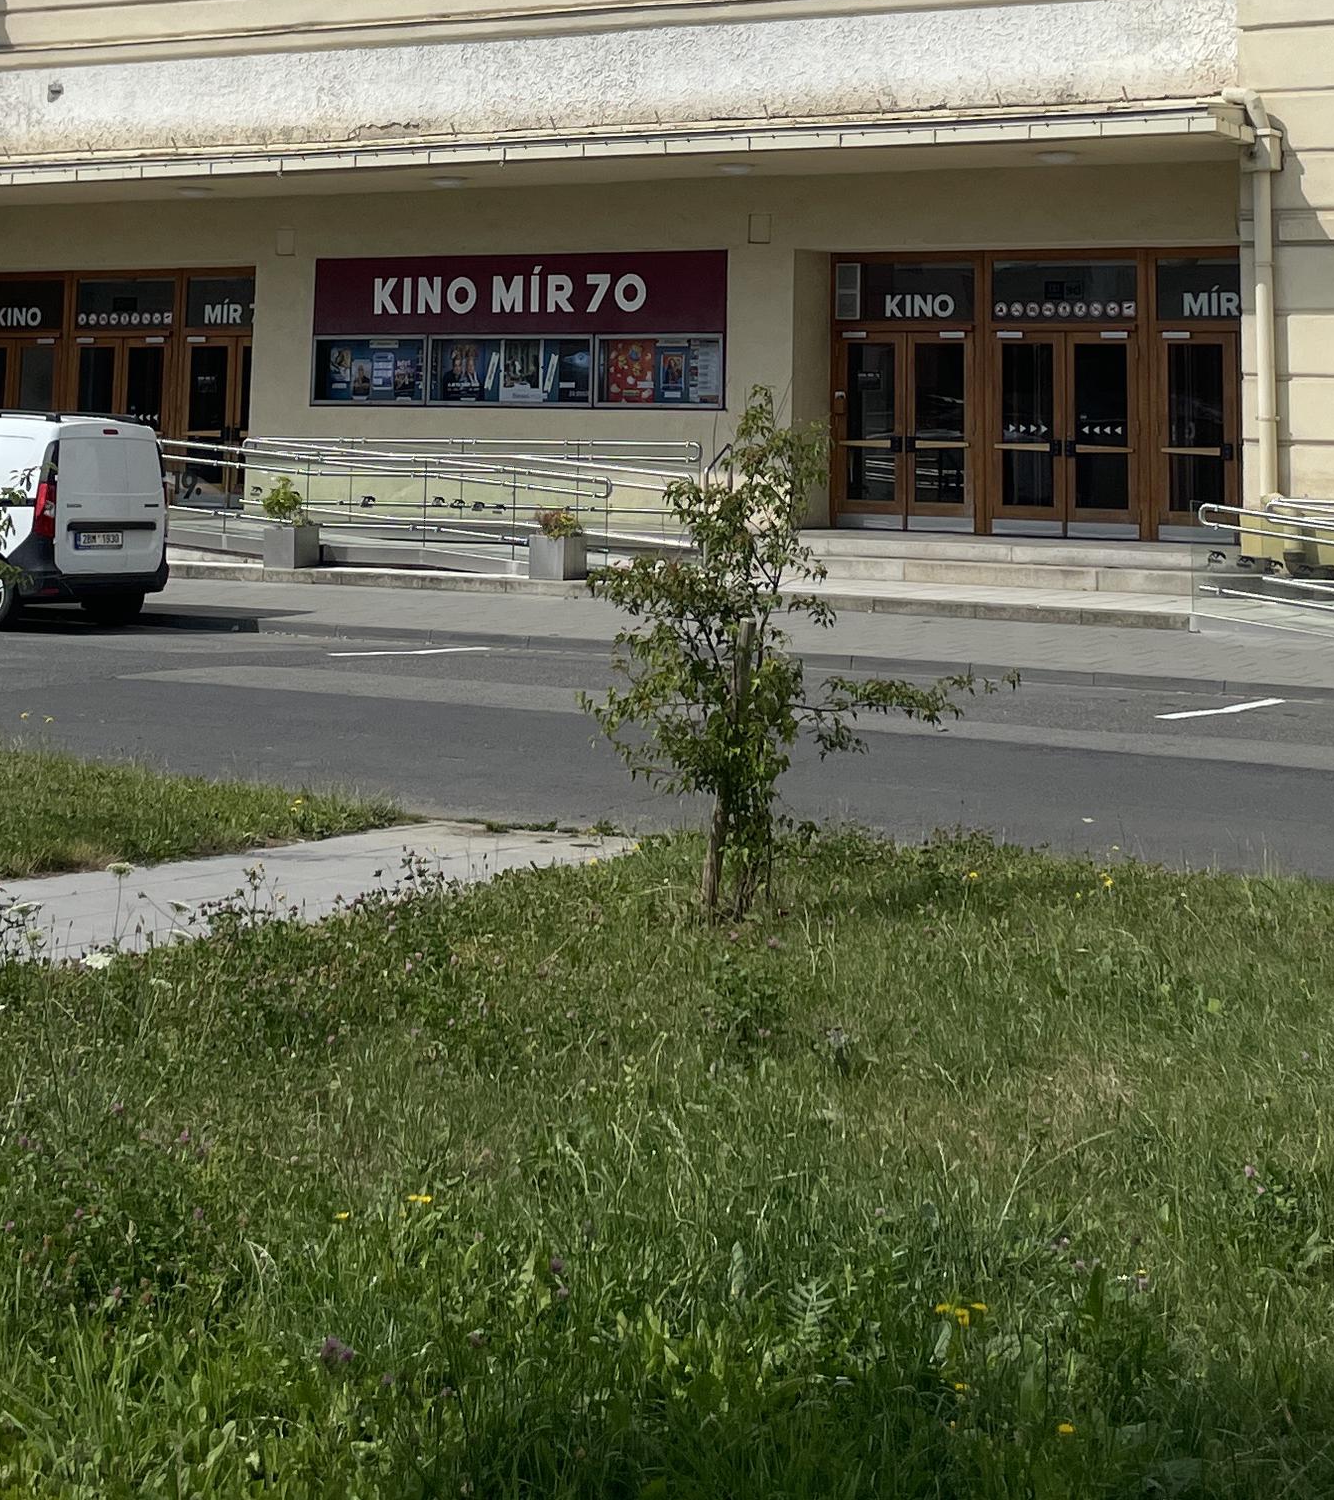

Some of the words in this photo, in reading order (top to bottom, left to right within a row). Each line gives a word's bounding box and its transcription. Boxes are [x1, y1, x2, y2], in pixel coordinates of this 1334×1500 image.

[373, 276, 477, 315] KINO
[491, 265, 575, 314] MÍR
[585, 272, 648, 314] 70
[885, 294, 955, 318] KINO
[1182, 284, 1240, 318] MÍR
[203, 298, 243, 325] MÍR
